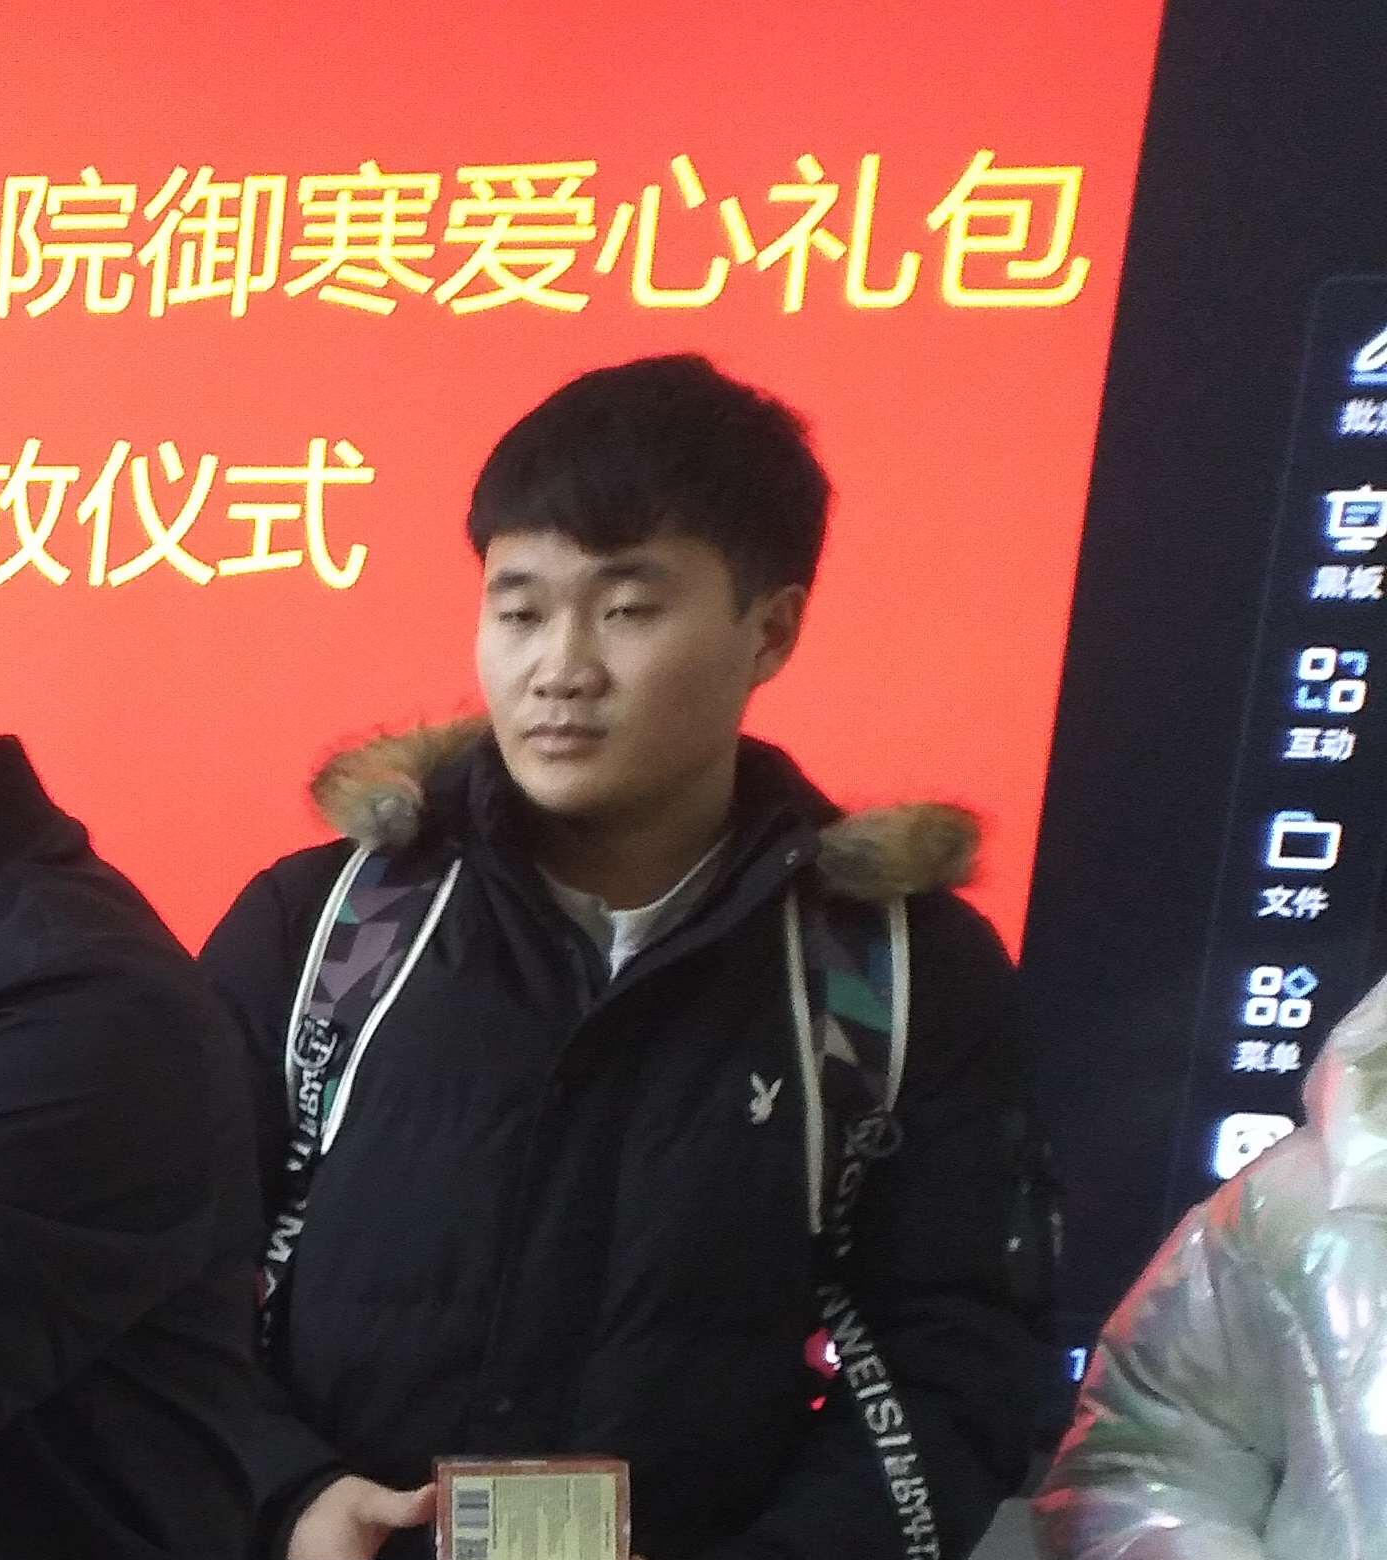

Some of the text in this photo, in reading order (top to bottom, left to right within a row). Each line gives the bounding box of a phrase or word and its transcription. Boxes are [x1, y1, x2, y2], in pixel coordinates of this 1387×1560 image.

[1282, 726, 1357, 762] 互动
[1257, 885, 1330, 920] 文件
[1232, 1040, 1302, 1075] 菜单
